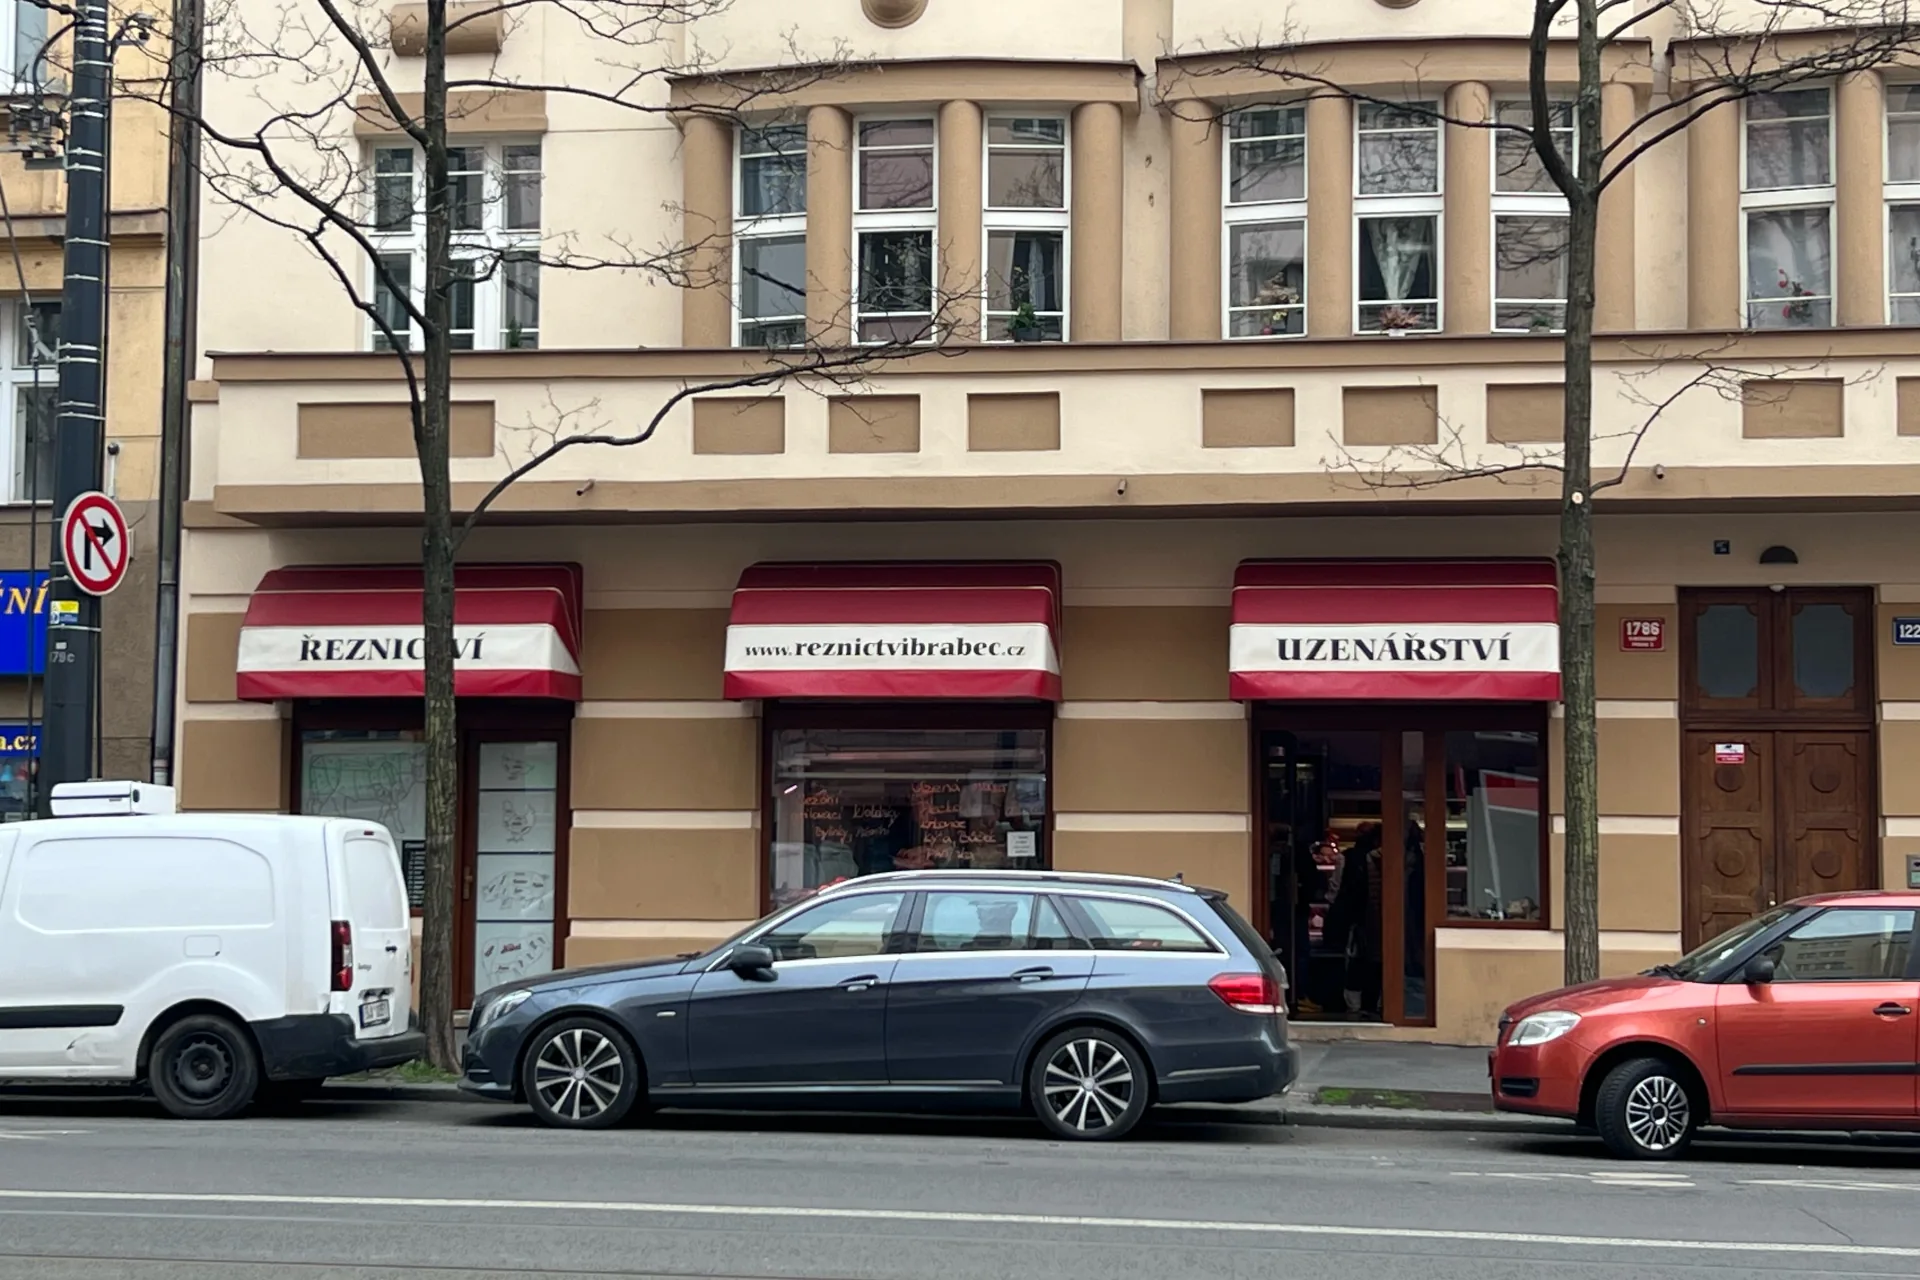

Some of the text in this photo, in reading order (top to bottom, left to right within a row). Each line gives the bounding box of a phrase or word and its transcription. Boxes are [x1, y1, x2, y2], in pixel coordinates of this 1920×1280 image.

[0, 579, 50, 614] NÍ
[1626, 622, 1660, 635] 1786
[300, 632, 486, 661] ŘEZNICVÍ
[745, 637, 1026, 657] www.reznictvibrabec.cz
[1276, 632, 1512, 661] UZENÁŘSTVÍ
